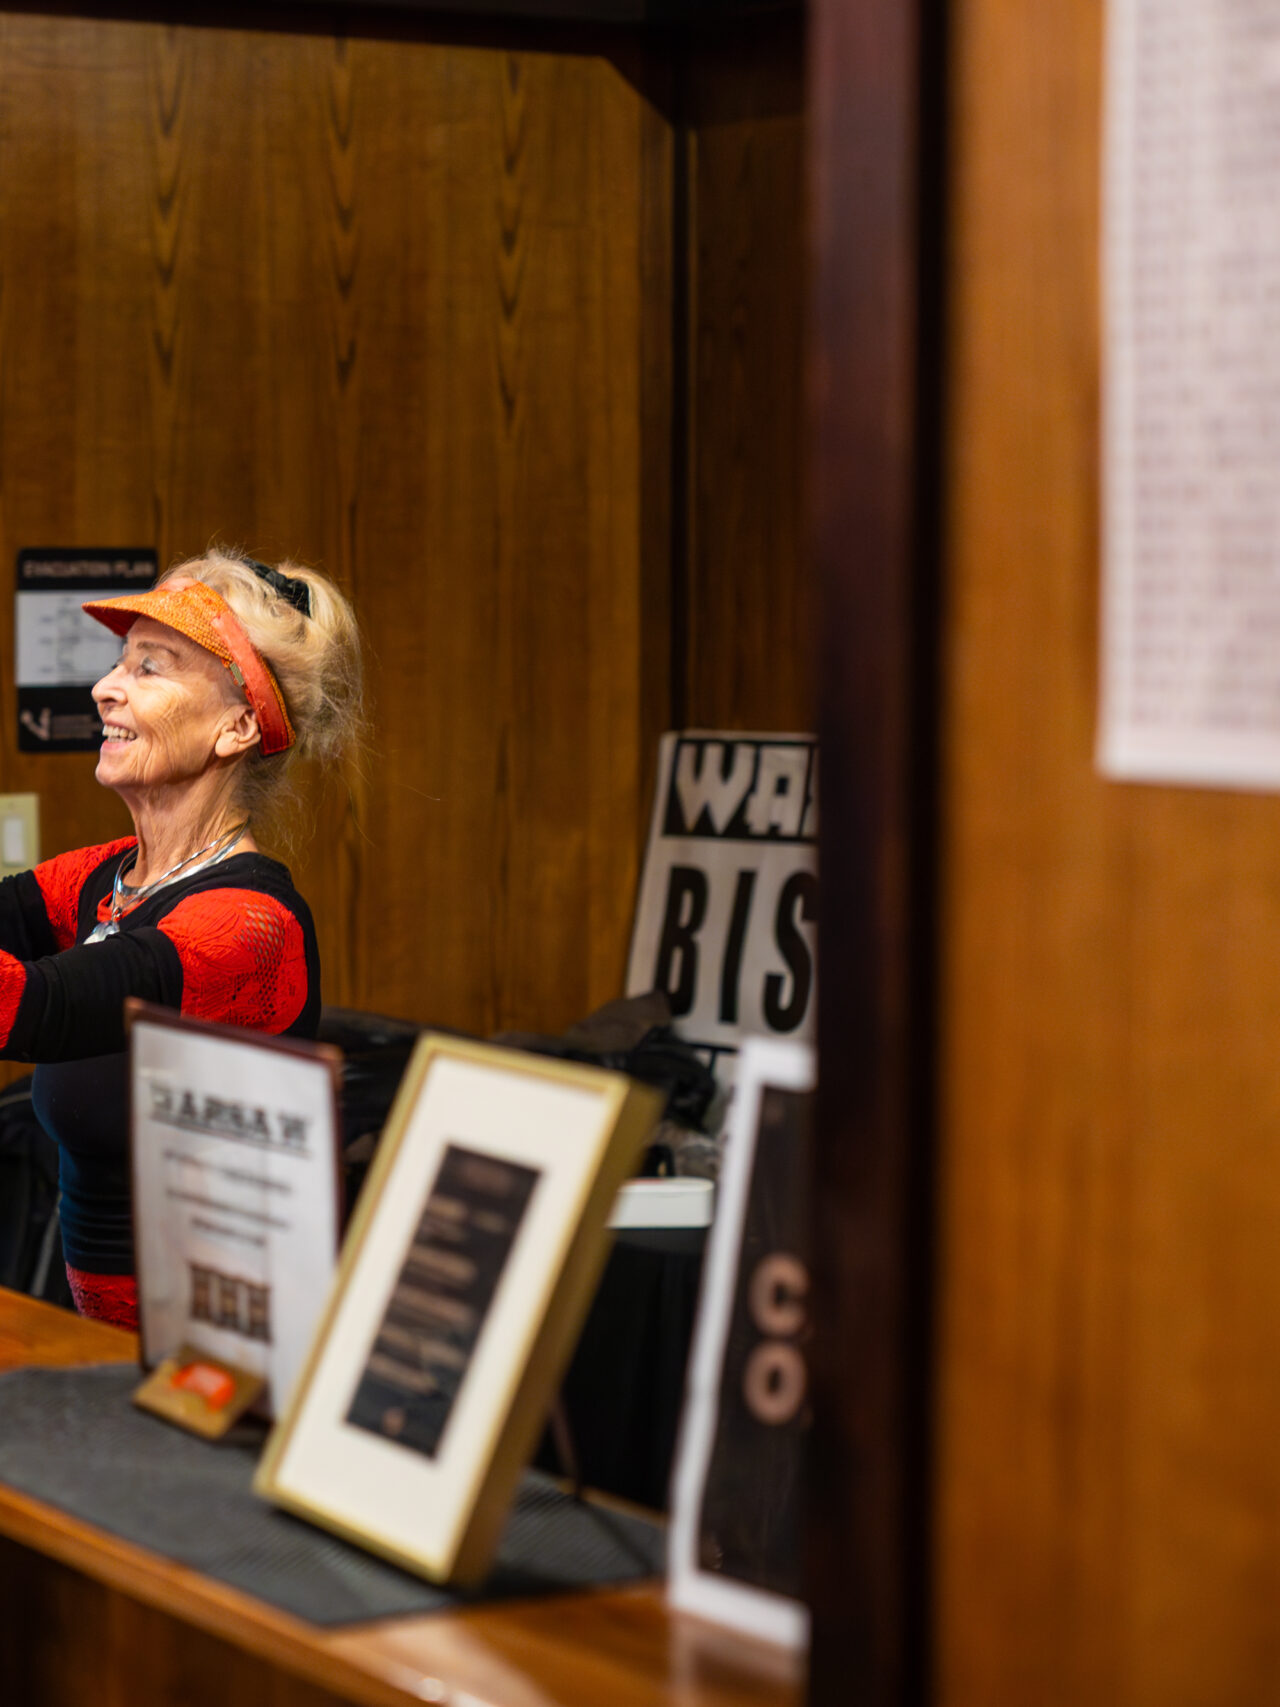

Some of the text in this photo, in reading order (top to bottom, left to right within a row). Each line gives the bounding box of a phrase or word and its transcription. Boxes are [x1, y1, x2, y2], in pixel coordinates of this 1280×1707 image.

[23, 560, 154, 578] EVACUATION PLAN
[674, 741, 817, 839] WA
